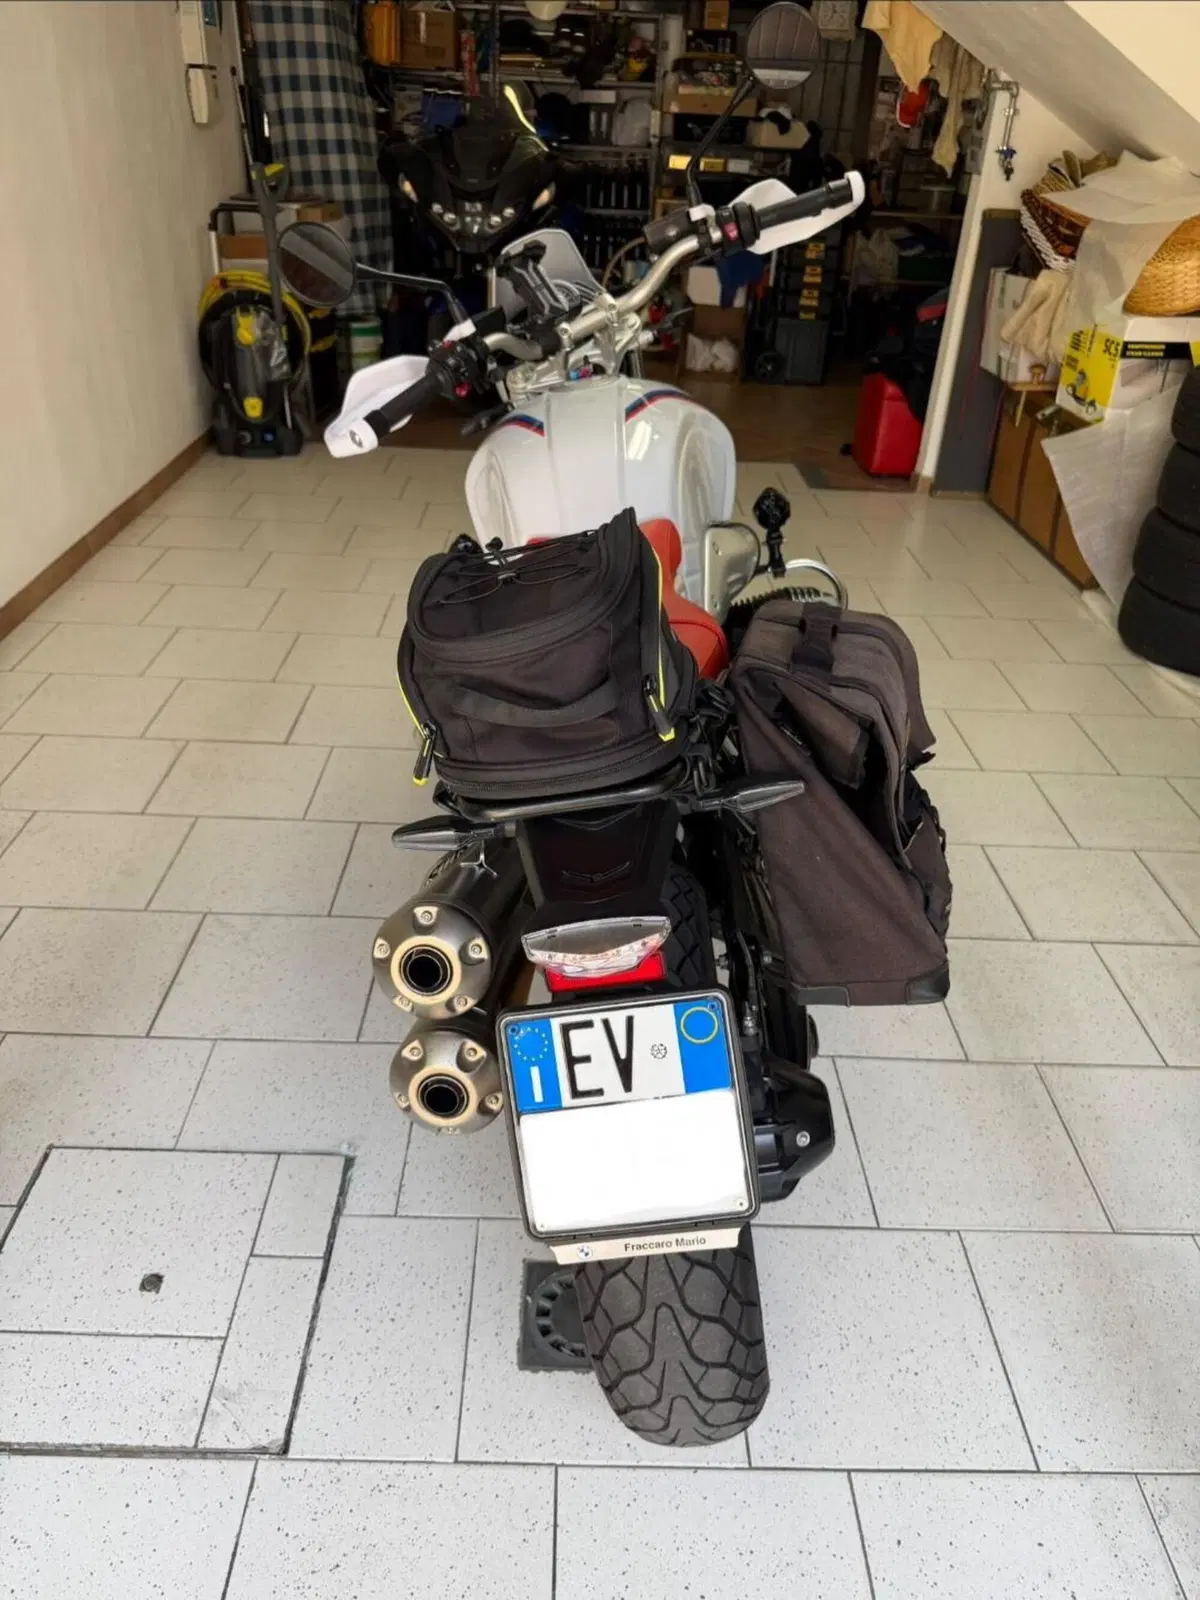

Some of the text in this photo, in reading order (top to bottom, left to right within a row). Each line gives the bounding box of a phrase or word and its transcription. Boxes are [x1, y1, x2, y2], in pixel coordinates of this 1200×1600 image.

[560, 1016, 634, 1099] EV
[624, 1236, 706, 1252] Fraccaro Mario
